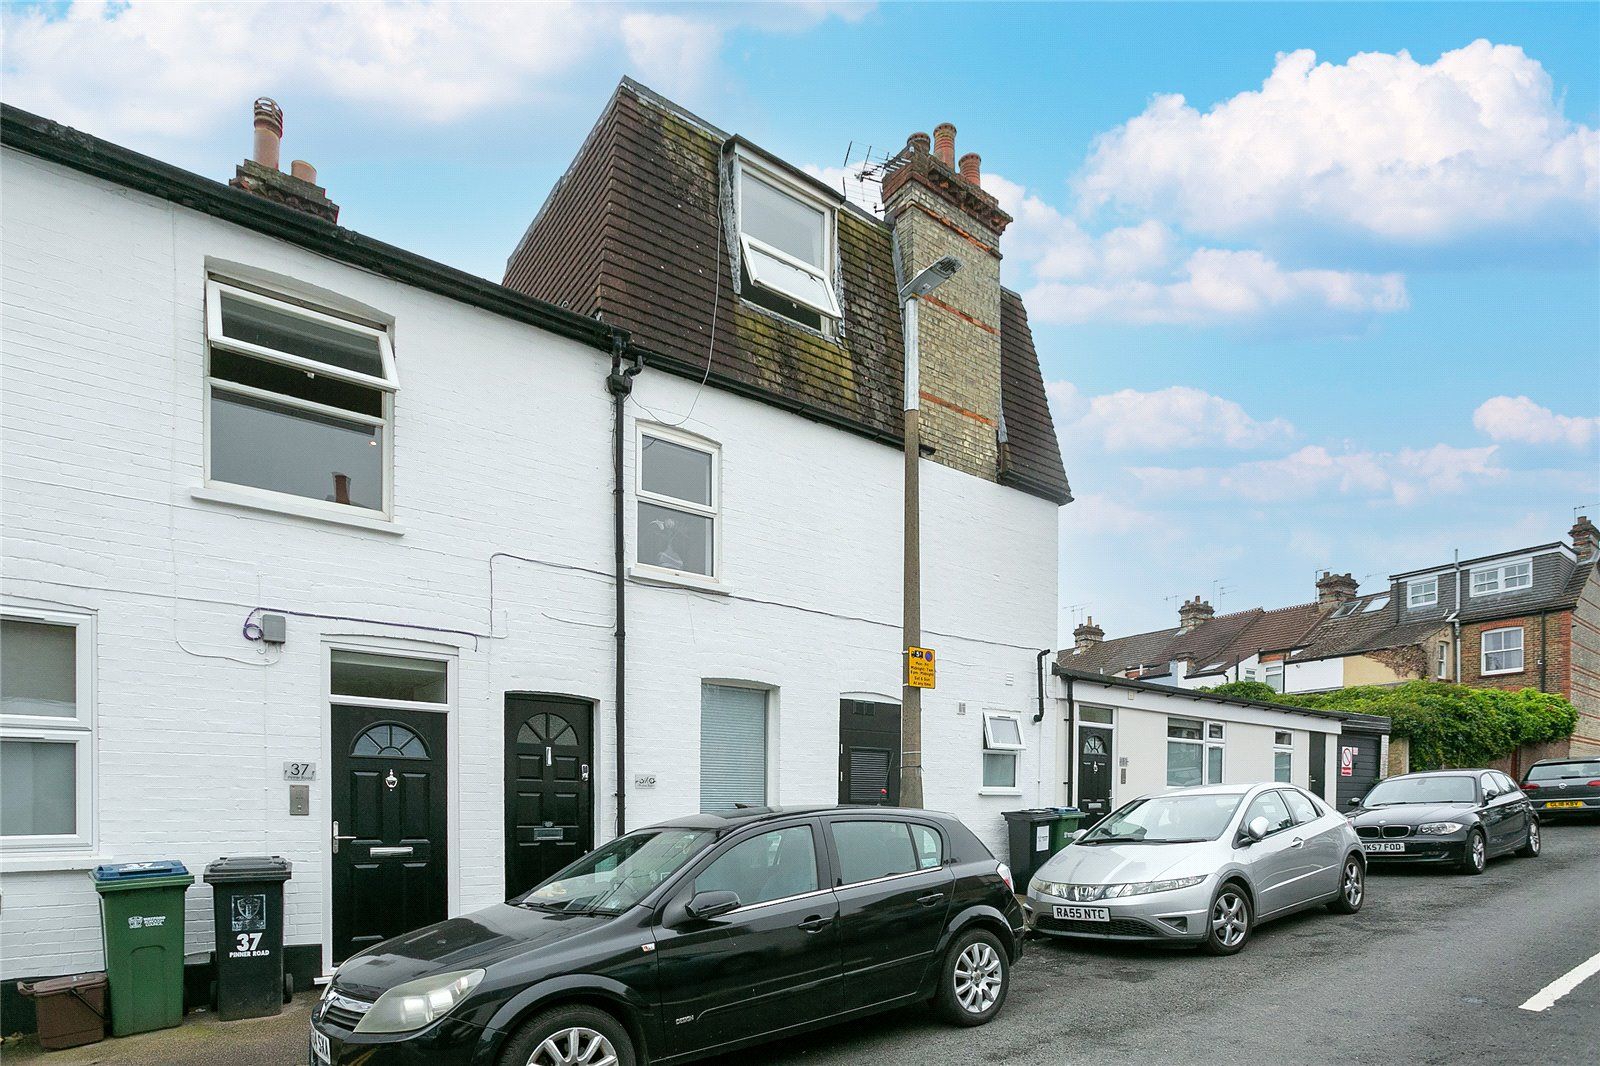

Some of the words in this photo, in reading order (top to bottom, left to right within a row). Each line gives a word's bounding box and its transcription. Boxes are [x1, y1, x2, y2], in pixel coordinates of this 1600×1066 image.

[291, 763, 309, 776] 37
[1056, 907, 1082, 918] RA55
[1083, 908, 1105, 920] NTC
[236, 932, 263, 952] 37
[229, 950, 252, 958] PINNER
[252, 949, 270, 957] ROAD
